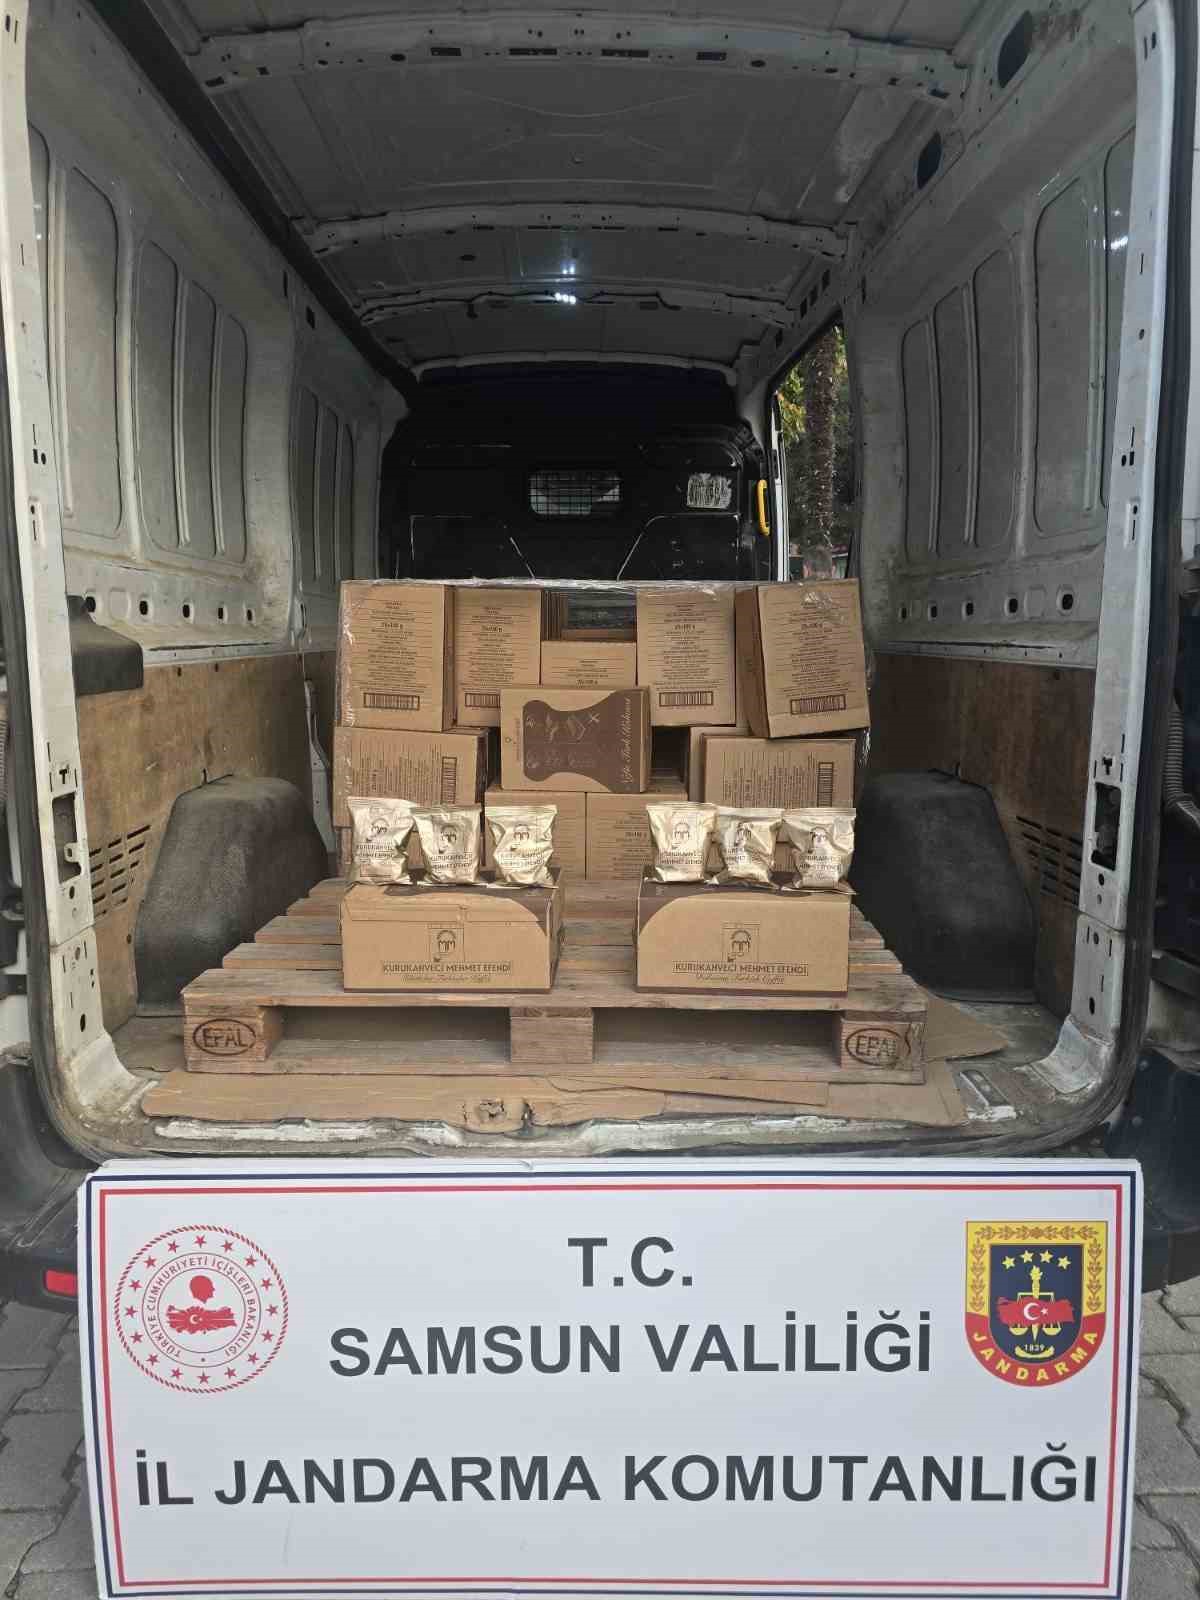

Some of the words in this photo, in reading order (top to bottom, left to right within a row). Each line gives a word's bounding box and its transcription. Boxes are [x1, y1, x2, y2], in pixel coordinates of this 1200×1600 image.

[148, 1256, 208, 1311] CUMHURİYETİ
[211, 1256, 255, 1297] İÇİŞLERİ
[568, 1237, 693, 1287] T.C.
[147, 1314, 182, 1358] TÜRKİYE
[224, 1298, 257, 1357] BAKANLIĞI
[329, 1325, 620, 1377] SAMSUN
[644, 1310, 930, 1374] VALİLİĞİ
[972, 1331, 1099, 1382] JANDARMA
[137, 1449, 194, 1507] İL
[215, 1456, 601, 1506] JANDARMA
[625, 1442, 1097, 1503] KOMUTANLIĞI
